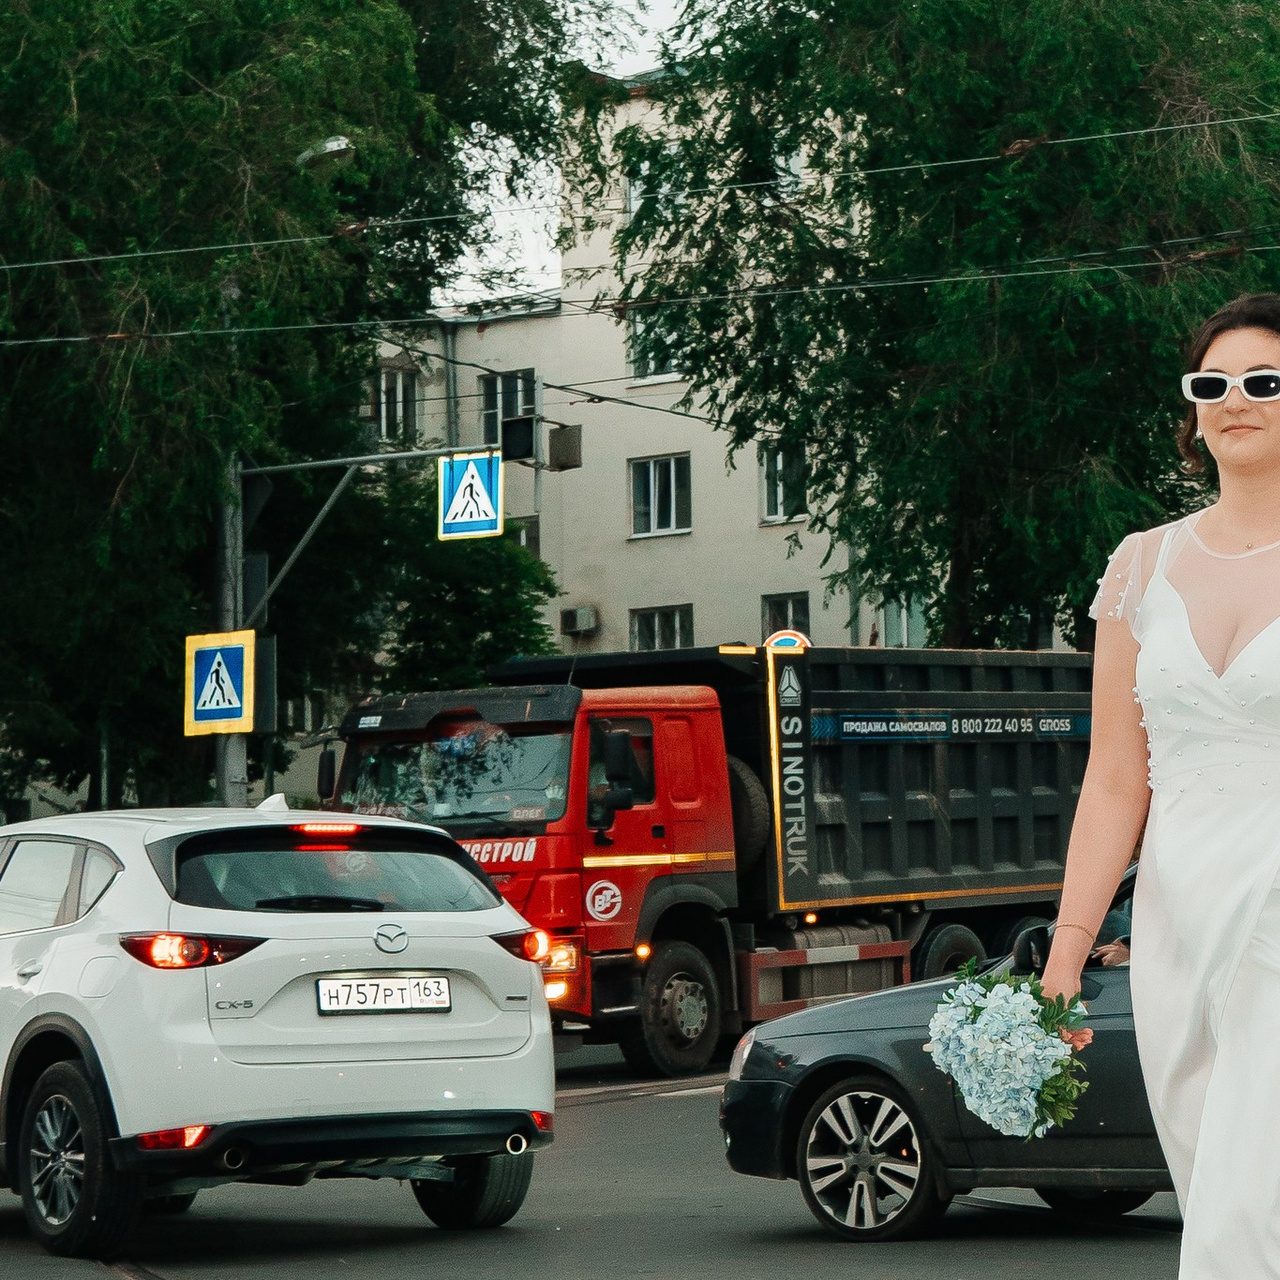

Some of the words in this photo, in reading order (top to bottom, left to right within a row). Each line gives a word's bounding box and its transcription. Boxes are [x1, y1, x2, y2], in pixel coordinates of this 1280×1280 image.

[843, 721, 887, 733] ПРОДАЖА
[889, 721, 947, 732] САМОСВАЛОВ
[952, 719, 959, 733] 8
[961, 719, 982, 733] 800
[984, 719, 1002, 732] 222
[1005, 718, 1018, 732] 40
[1020, 718, 1033, 732] 95
[1039, 718, 1071, 732] GROSS
[780, 715, 809, 877] SINOTRUK
[413, 981, 442, 997] 163
[215, 1000, 253, 1009] CX-5
